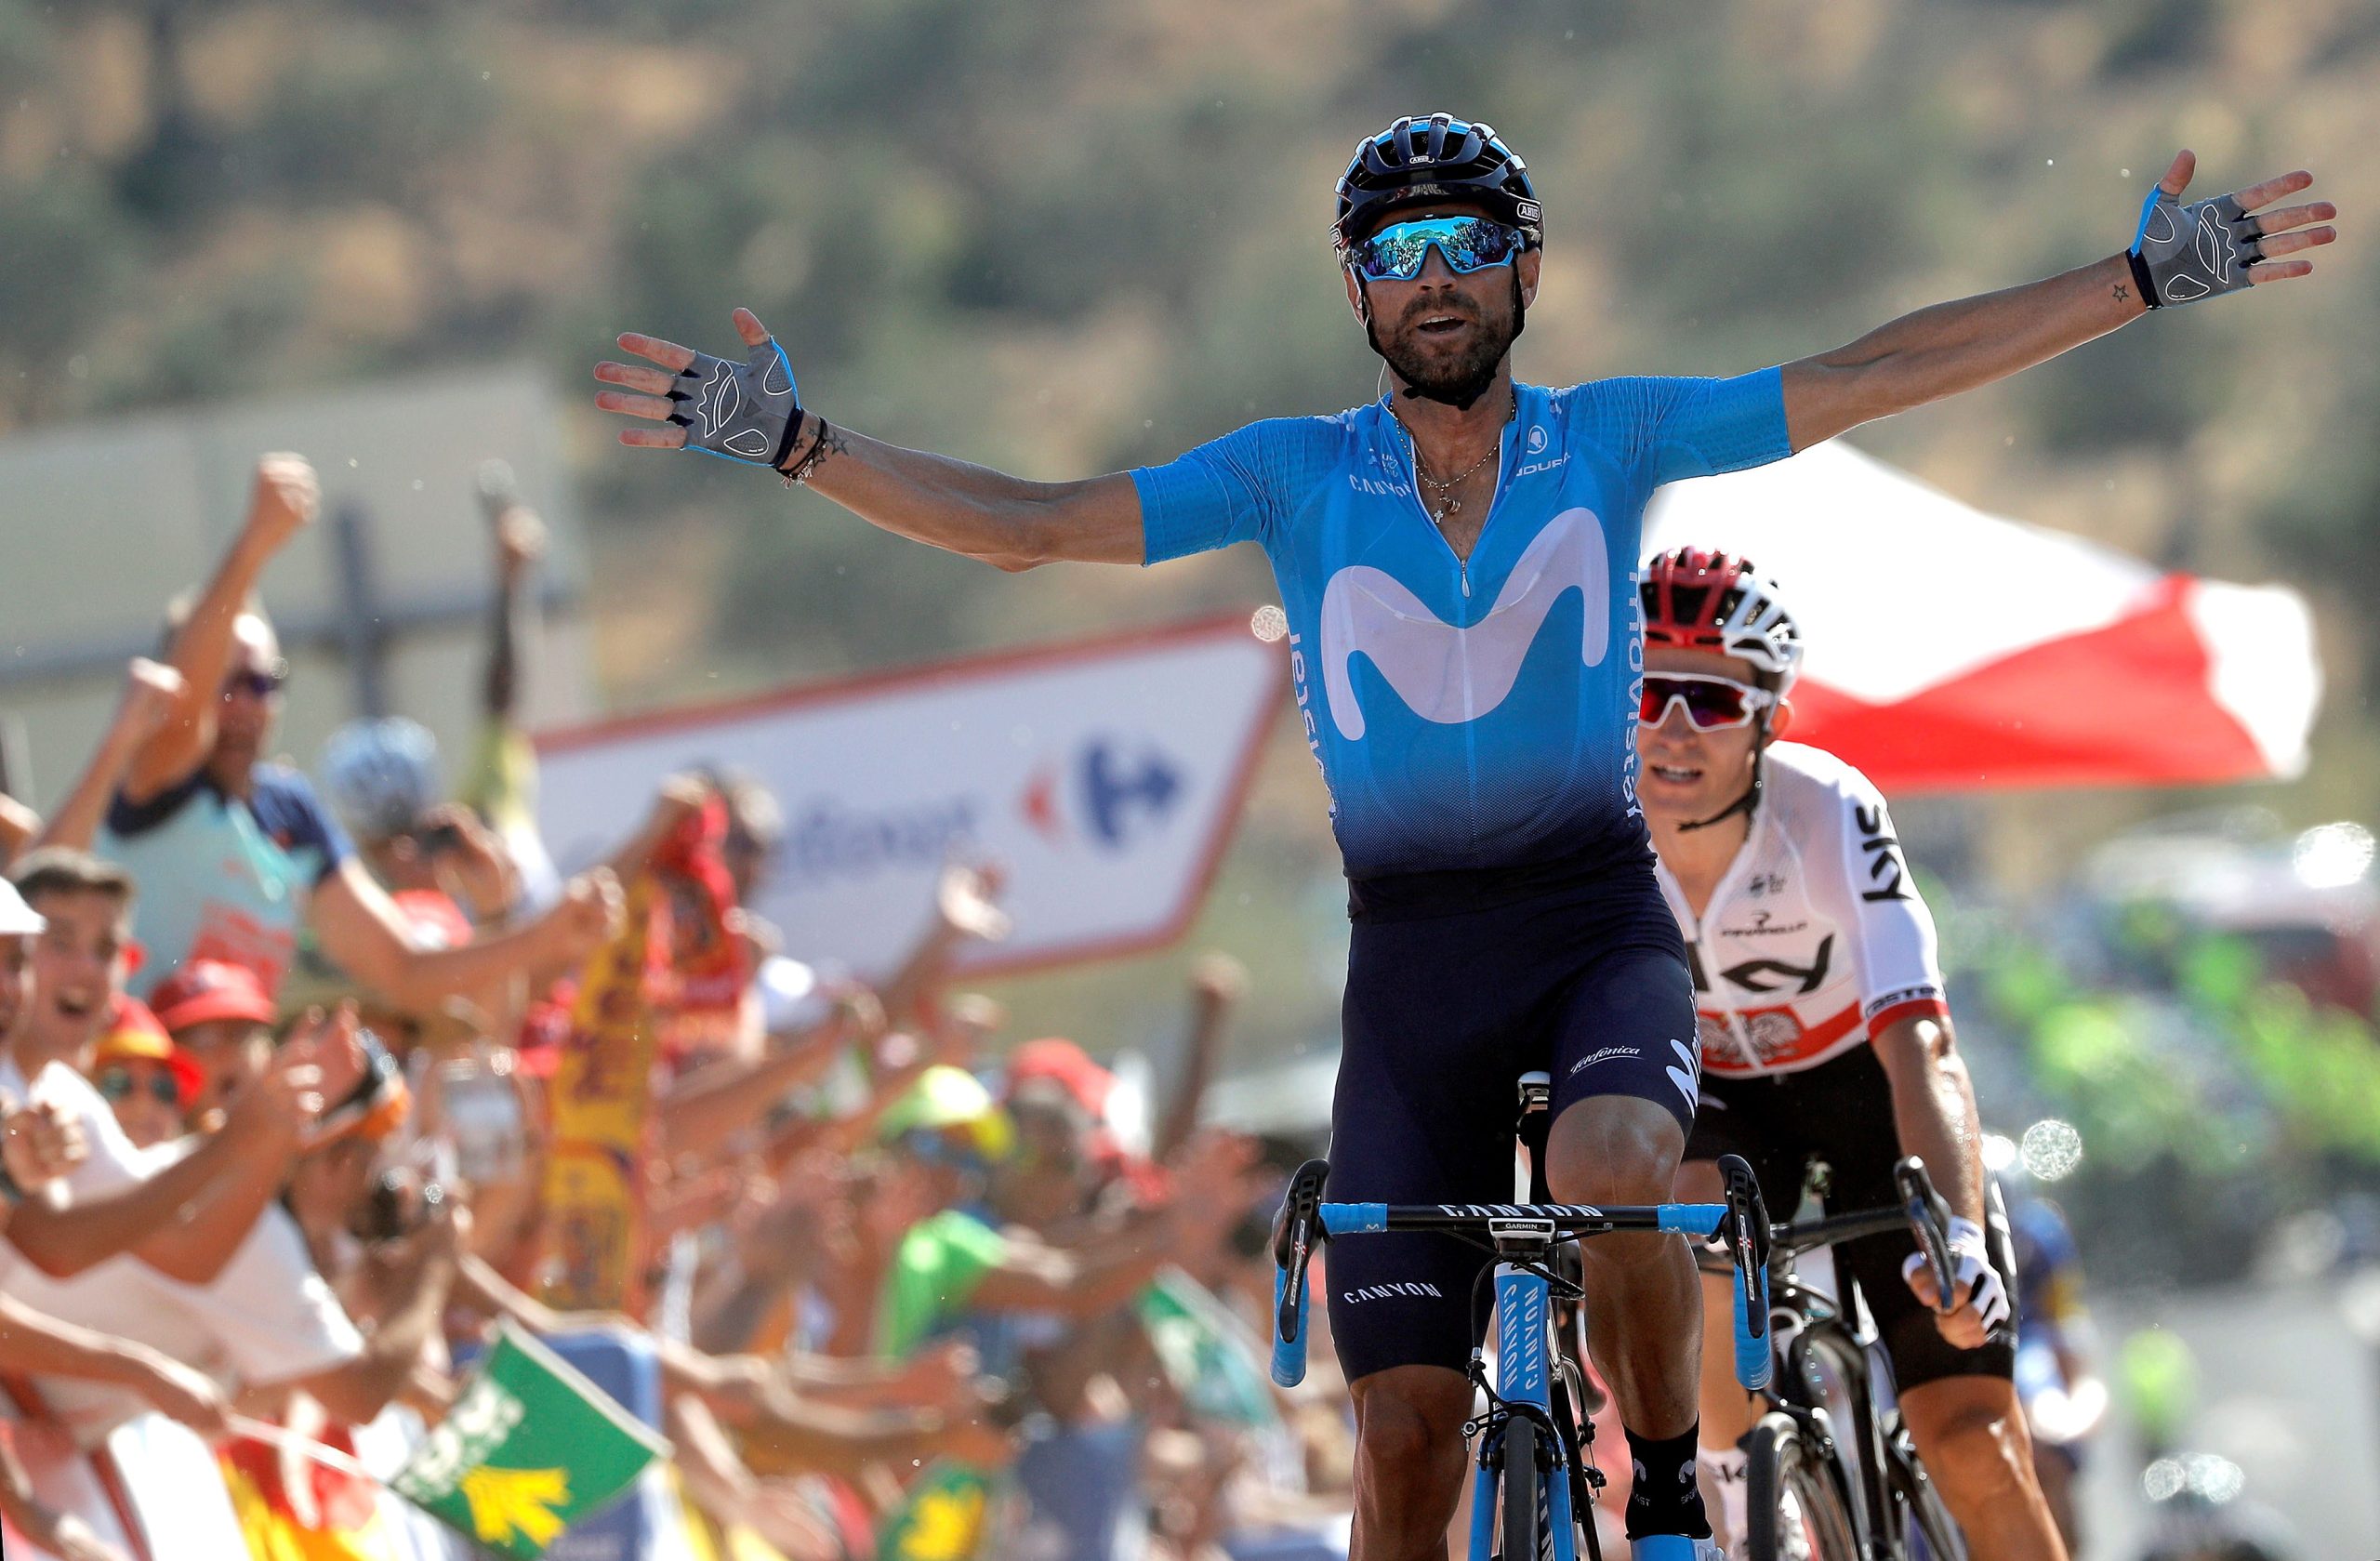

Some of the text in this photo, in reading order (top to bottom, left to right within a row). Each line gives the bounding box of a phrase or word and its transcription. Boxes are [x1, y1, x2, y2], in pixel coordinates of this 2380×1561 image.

[1520, 205, 1539, 218] ABUS
[1622, 571, 1645, 819] movistar
[1505, 1222, 1538, 1230] GARMIN
[1343, 1282, 1442, 1303] CANYON
[1503, 1284, 1517, 1391] CANYON
[1525, 1286, 1539, 1390] CANYON
